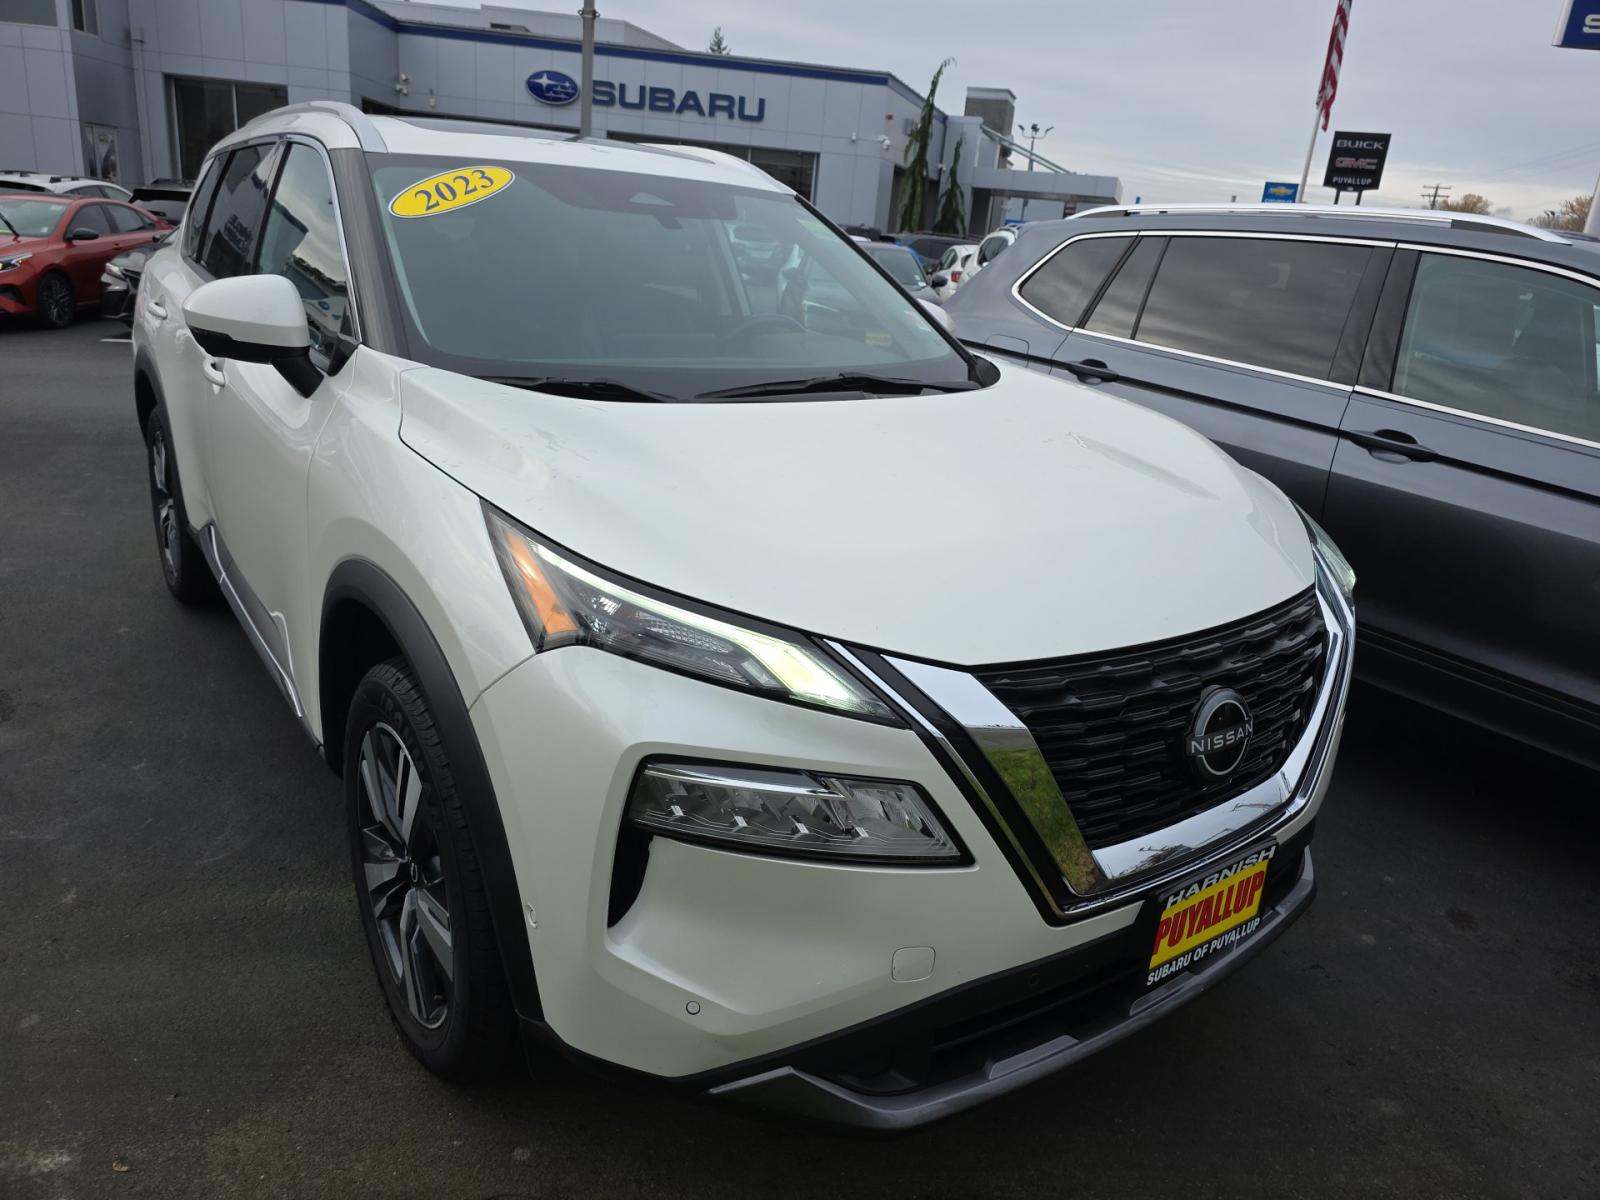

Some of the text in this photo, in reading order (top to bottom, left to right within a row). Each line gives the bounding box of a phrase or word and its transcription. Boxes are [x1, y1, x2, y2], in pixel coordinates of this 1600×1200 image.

[592, 79, 766, 122] SUBARU
[1335, 156, 1378, 170] GMC
[1336, 139, 1384, 150] BUICK
[414, 169, 494, 211] 2023
[1332, 176, 1373, 185] PUYALLUP
[1191, 723, 1253, 754] NISSAN
[1164, 845, 1277, 909] HARNISH
[1152, 870, 1265, 956] PUYALLUP
[1146, 917, 1260, 986] SUBARU OF PUYALLUP
